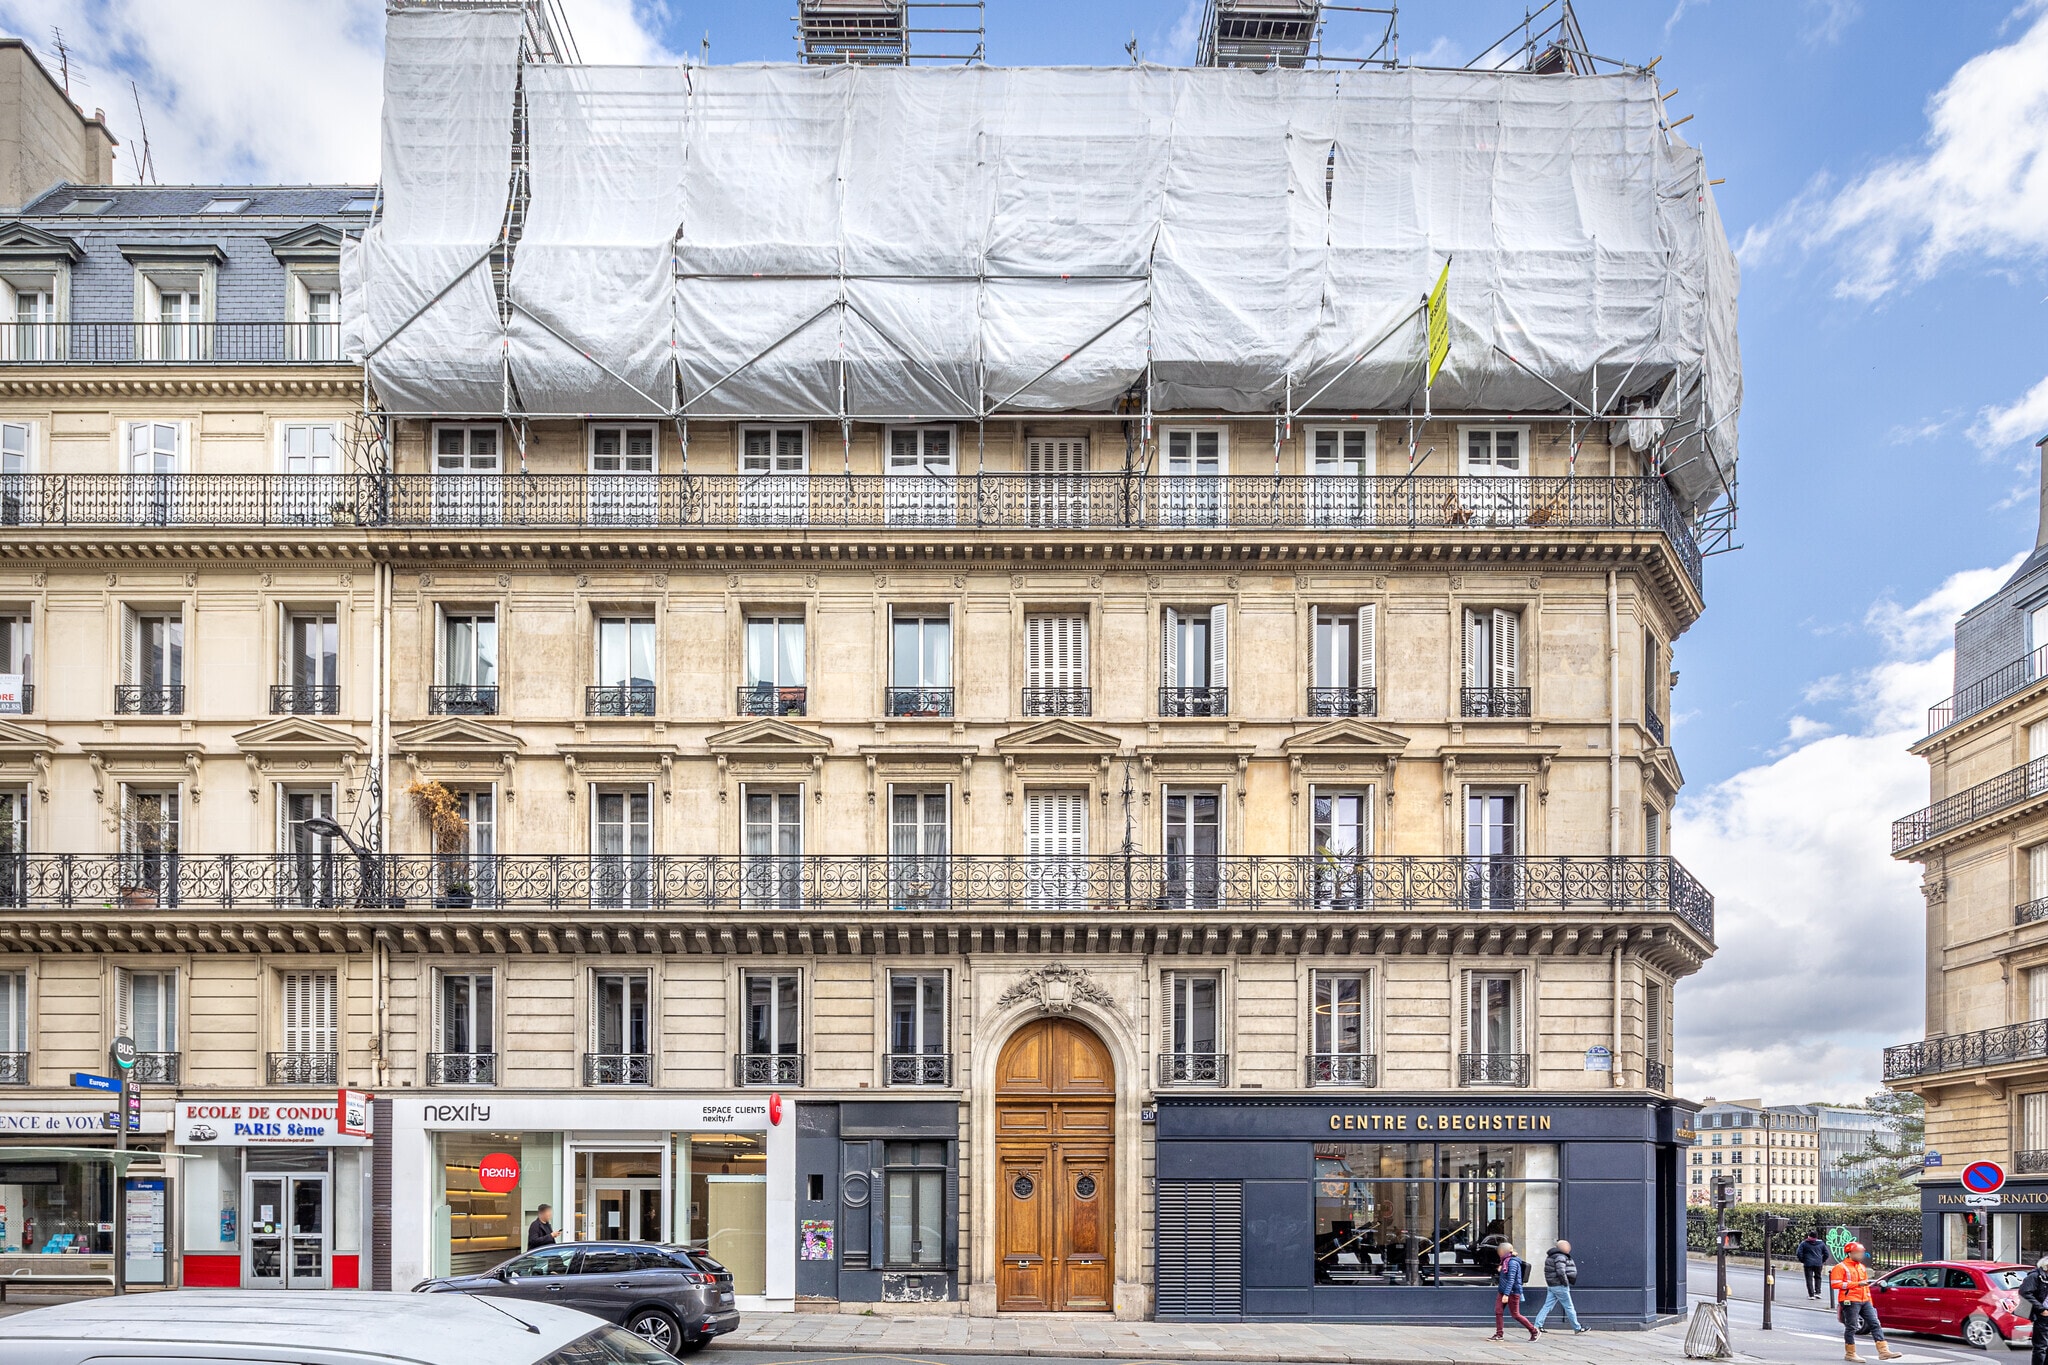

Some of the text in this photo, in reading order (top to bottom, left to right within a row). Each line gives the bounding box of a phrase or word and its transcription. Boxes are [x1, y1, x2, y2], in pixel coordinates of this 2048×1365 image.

[0, 693, 14, 701] RE
[117, 1042, 134, 1055] BUS
[88, 1078, 110, 1088] Europe
[130, 1084, 139, 1092] 28
[187, 1106, 241, 1119] ECOLE
[248, 1107, 270, 1119] DE
[424, 1103, 491, 1121] nexity
[702, 1106, 766, 1114] ESPACE CLIENTS
[1143, 1110, 1154, 1120] 50
[46, 1117, 60, 1129] de
[702, 1114, 734, 1123] nexity.fr
[1329, 1114, 1407, 1130] CENTRE
[234, 1122, 325, 1136] PARIS 8ème
[481, 1167, 517, 1178] nexity
